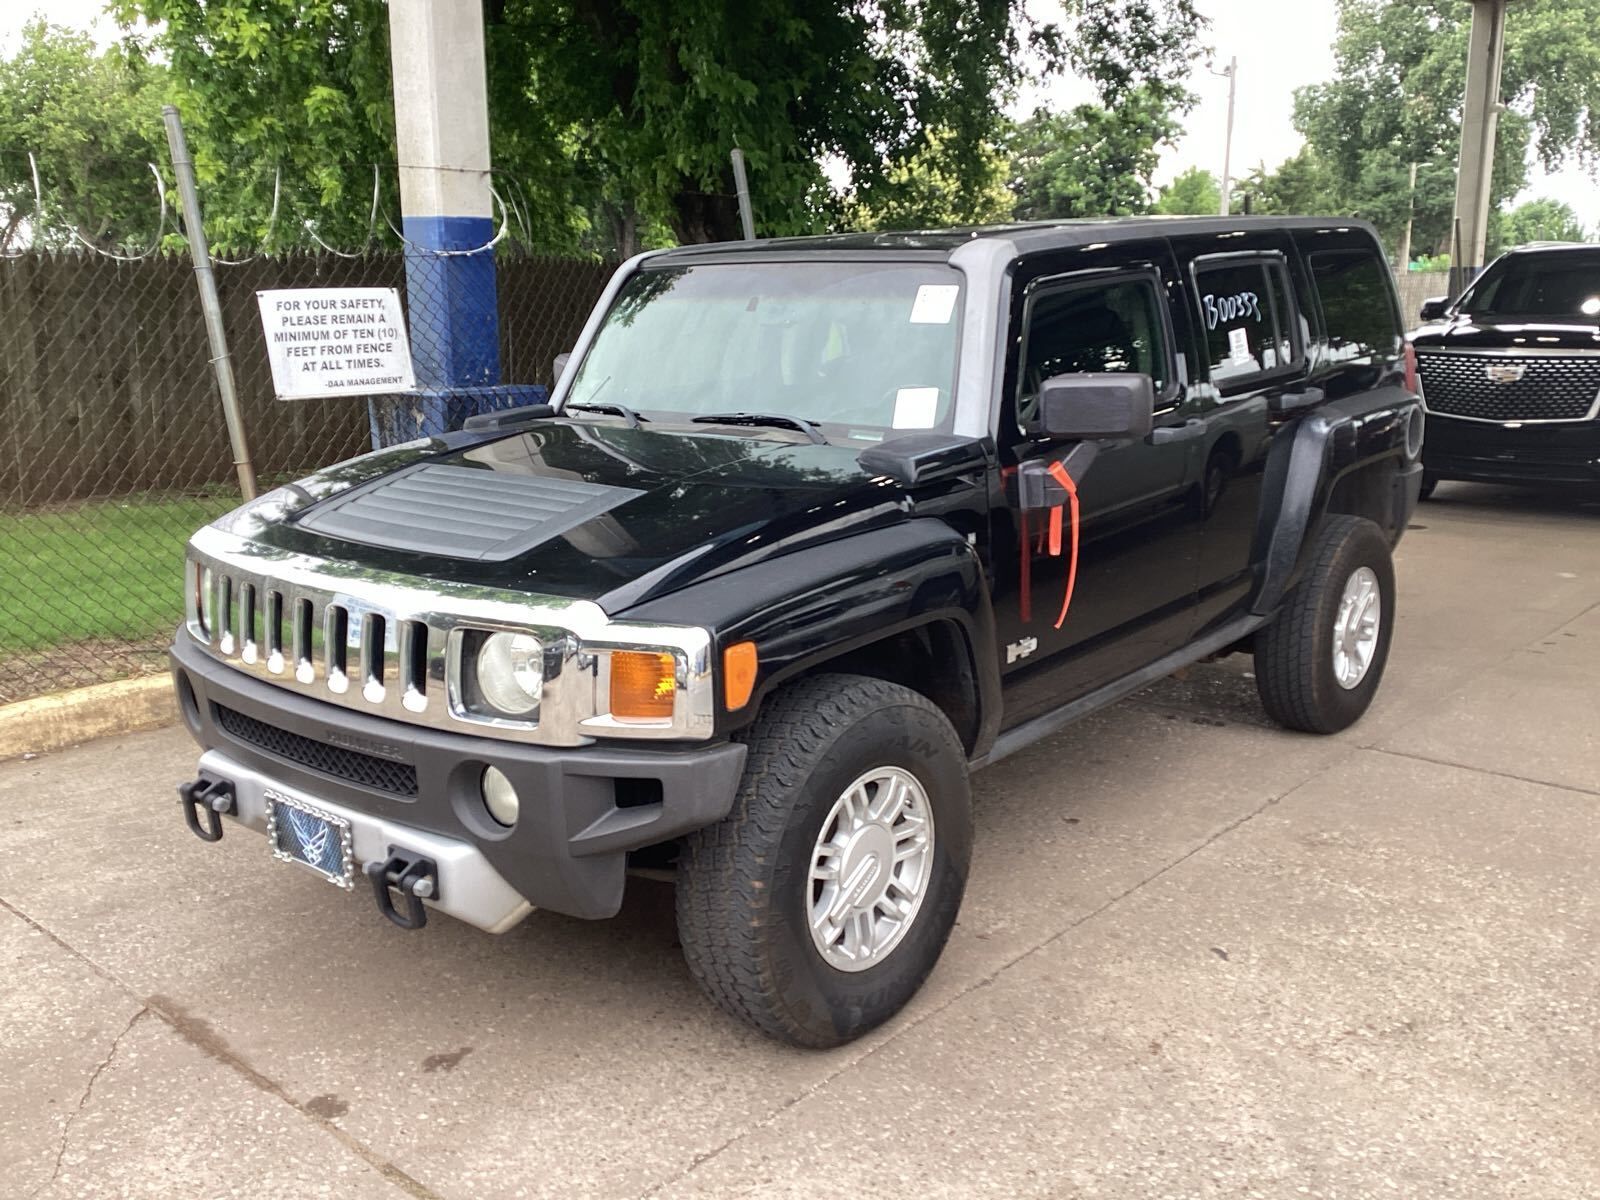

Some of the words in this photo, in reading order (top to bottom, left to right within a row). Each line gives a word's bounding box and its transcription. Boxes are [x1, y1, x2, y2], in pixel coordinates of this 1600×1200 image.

[276, 300, 300, 311] FOR
[304, 299, 337, 310] YOUR
[340, 298, 385, 310] SAFETY,
[282, 315, 327, 327] PLEASE
[330, 314, 375, 325] REMAIN
[378, 314, 386, 323] A
[274, 330, 330, 342] MINIMUM
[333, 329, 348, 340] OF
[352, 328, 374, 339] TEN
[377, 327, 398, 340] (10)
[286, 346, 316, 357] FEET
[320, 344, 352, 356] FROM
[356, 342, 393, 354] FENCE
[302, 361, 317, 372] AT
[320, 359, 343, 371] ALL
[345, 358, 384, 369] TIMES.
[347, 376, 403, 387] MANAGEMENT
